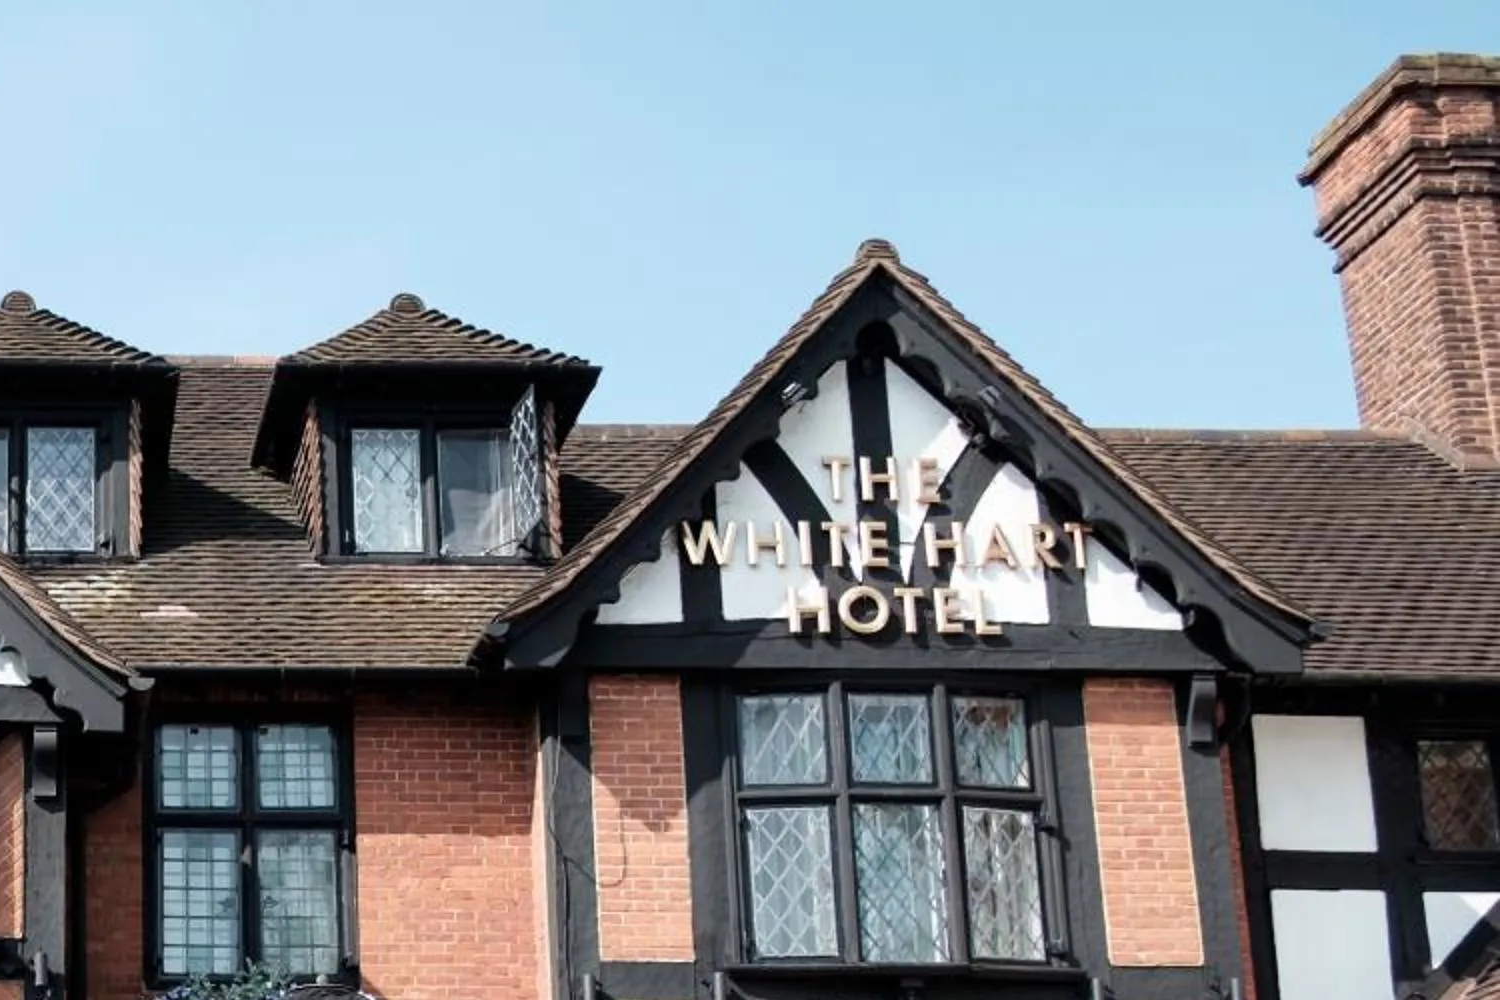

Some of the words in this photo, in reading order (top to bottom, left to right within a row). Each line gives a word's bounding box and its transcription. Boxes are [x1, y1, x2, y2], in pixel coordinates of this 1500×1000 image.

[821, 455, 941, 504] THE
[680, 519, 890, 568] WHITE
[924, 521, 1094, 570] HART
[784, 585, 1004, 636] HOTEL
